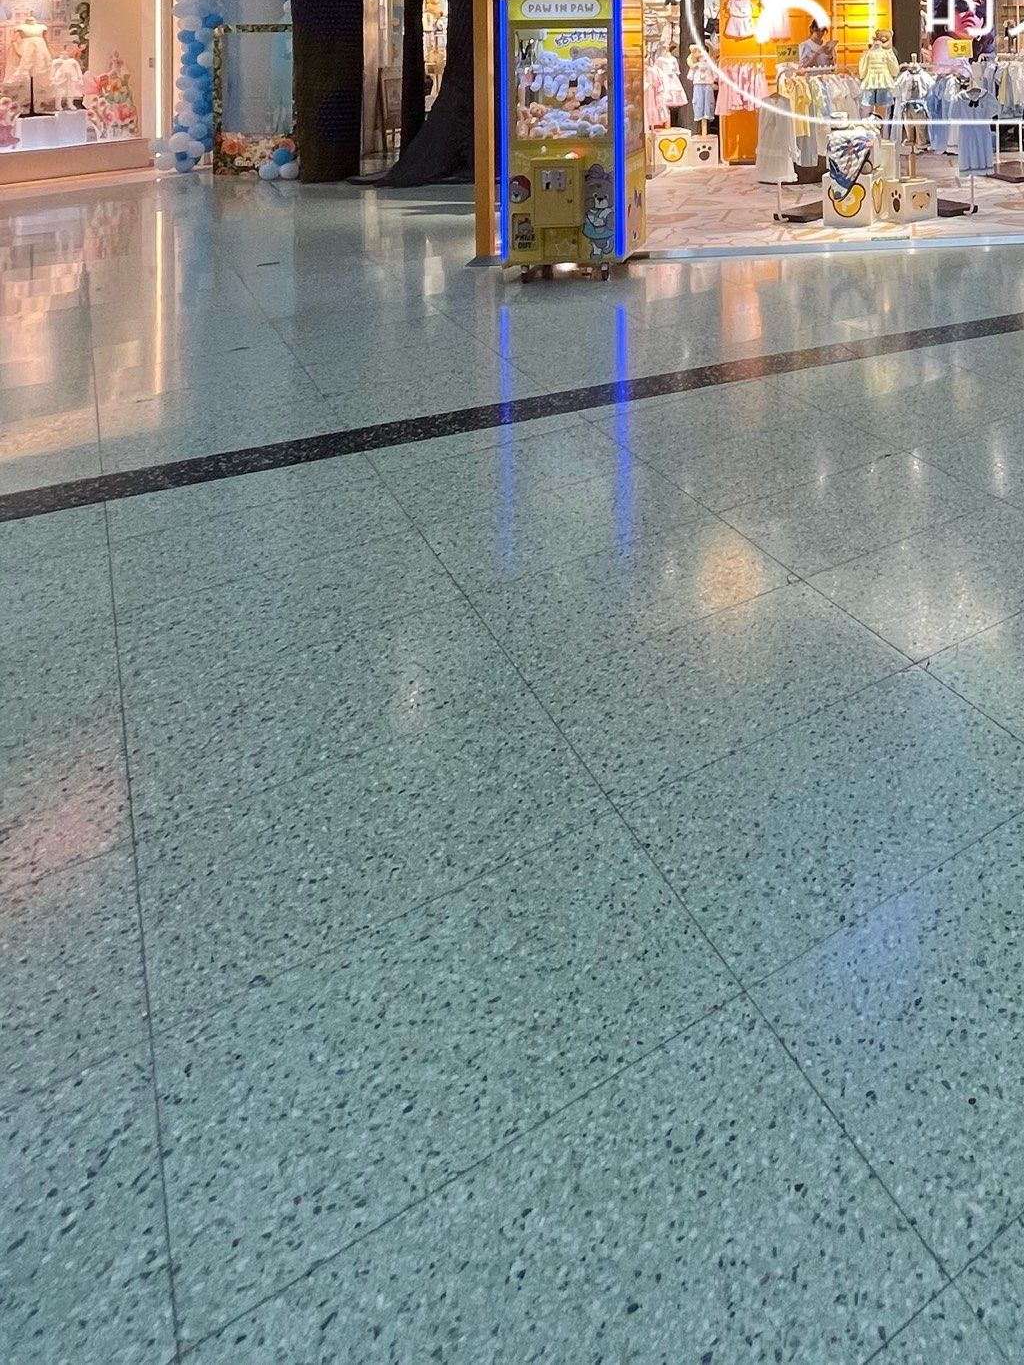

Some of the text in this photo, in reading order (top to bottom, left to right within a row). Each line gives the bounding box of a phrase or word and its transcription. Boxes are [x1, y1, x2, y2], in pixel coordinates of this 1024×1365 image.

[528, 2, 594, 14] PAW IN PAW
